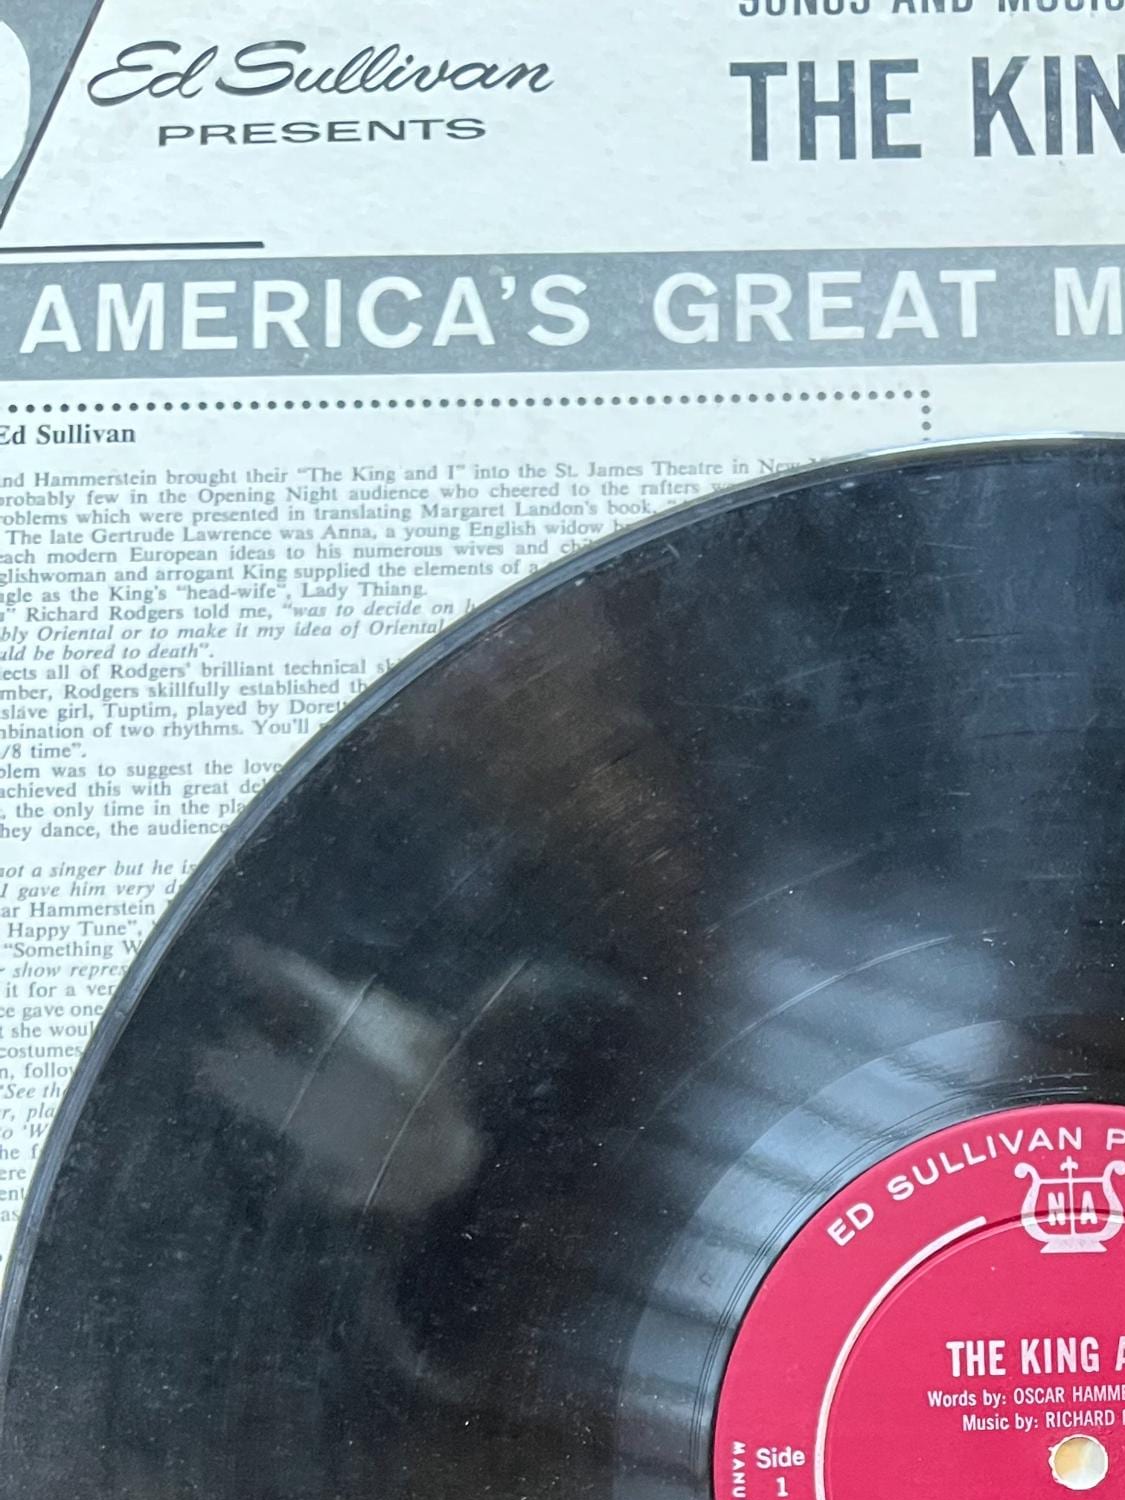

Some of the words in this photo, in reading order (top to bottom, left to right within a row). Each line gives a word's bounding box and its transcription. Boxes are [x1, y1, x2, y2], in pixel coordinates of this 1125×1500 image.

[86, 41, 214, 107] Ed
[214, 40, 555, 99] Sullivan
[730, 59, 922, 162] THE
[157, 117, 488, 148] PRESENTS
[19, 272, 591, 355] AMERICA'S
[652, 268, 997, 346] GREAT
[36, 423, 136, 445] Sullivan
[0, 472, 25, 488] nd
[35, 469, 157, 488] Hammerstein
[166, 468, 237, 487] brought
[246, 468, 288, 483] their
[352, 465, 396, 484] King
[404, 464, 438, 481] and
[473, 463, 509, 480] into
[518, 463, 547, 480] the
[587, 461, 644, 478] James
[652, 460, 723, 477] Theatre
[732, 459, 749, 475] in
[50, 529, 84, 545] late
[91, 527, 175, 545] Gertrude
[183, 525, 272, 543] Lawrence
[280, 528, 314, 541] was
[320, 524, 377, 541] Anna,
[385, 527, 396, 538] a
[404, 525, 460, 541] young
[469, 520, 536, 539] English
[545, 518, 604, 535] widow
[41, 590, 61, 602] as
[70, 587, 99, 602] the
[109, 585, 167, 604] King's
[301, 582, 348, 600] Lady
[358, 581, 427, 598] Thiang.
[33, 645, 54, 661] be
[62, 644, 115, 660] bored
[122, 645, 141, 660] to
[64, 683, 139, 702] Rodgers
[148, 681, 230, 700] skillfully
[239, 680, 340, 697] established
[57, 701, 94, 721] girl,
[103, 701, 178, 721] Tuptim,
[186, 700, 247, 719] played
[257, 698, 279, 717] by
[41, 823, 101, 840] dance,
[111, 821, 139, 837] the
[29, 901, 156, 918] Hammerstein
[8, 922, 70, 940] Happy
[6, 982, 19, 997] it
[28, 981, 58, 998] for
[65, 986, 77, 997] a
[22, 1005, 65, 1021] gave
[11, 1021, 42, 1037] she
[827, 1202, 874, 1247] ED
[886, 1127, 1081, 1200] SULLIVAN
[945, 1339, 1007, 1378] THE
[1020, 1336, 1100, 1375] KING
[927, 1389, 977, 1408] Words
[982, 1389, 1007, 1409] by:
[1013, 1386, 1065, 1405] OSCAR
[962, 1413, 1010, 1432] Music
[1014, 1412, 1039, 1433] by:
[1045, 1409, 1116, 1429] RICHARD
[755, 1445, 806, 1470] Side
[775, 1476, 789, 1498] 1
